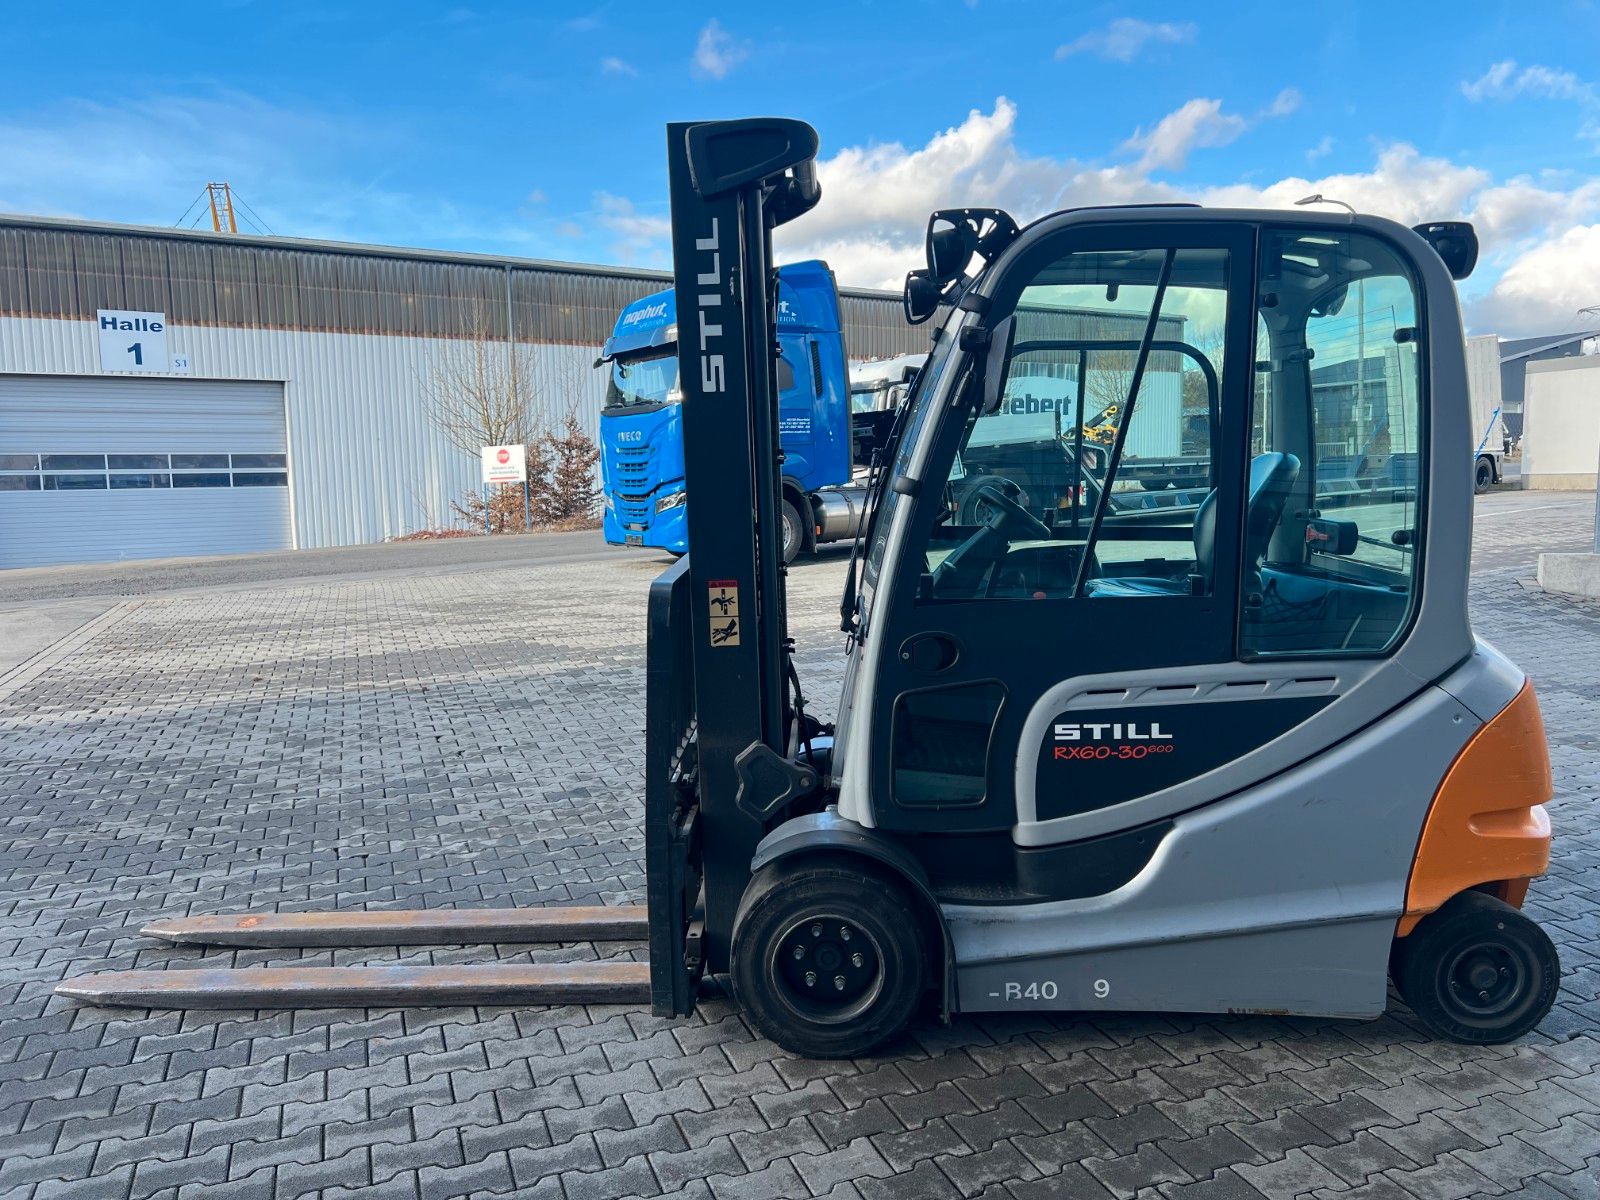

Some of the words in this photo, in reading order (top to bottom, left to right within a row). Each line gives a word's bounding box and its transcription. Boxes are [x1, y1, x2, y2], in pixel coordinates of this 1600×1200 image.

[696, 217, 725, 392] STILL
[101, 316, 163, 332] Halle
[127, 342, 143, 365] 1
[617, 431, 641, 441] IVECO
[1054, 722, 1173, 740] STILL
[1094, 979, 1110, 998] 9
